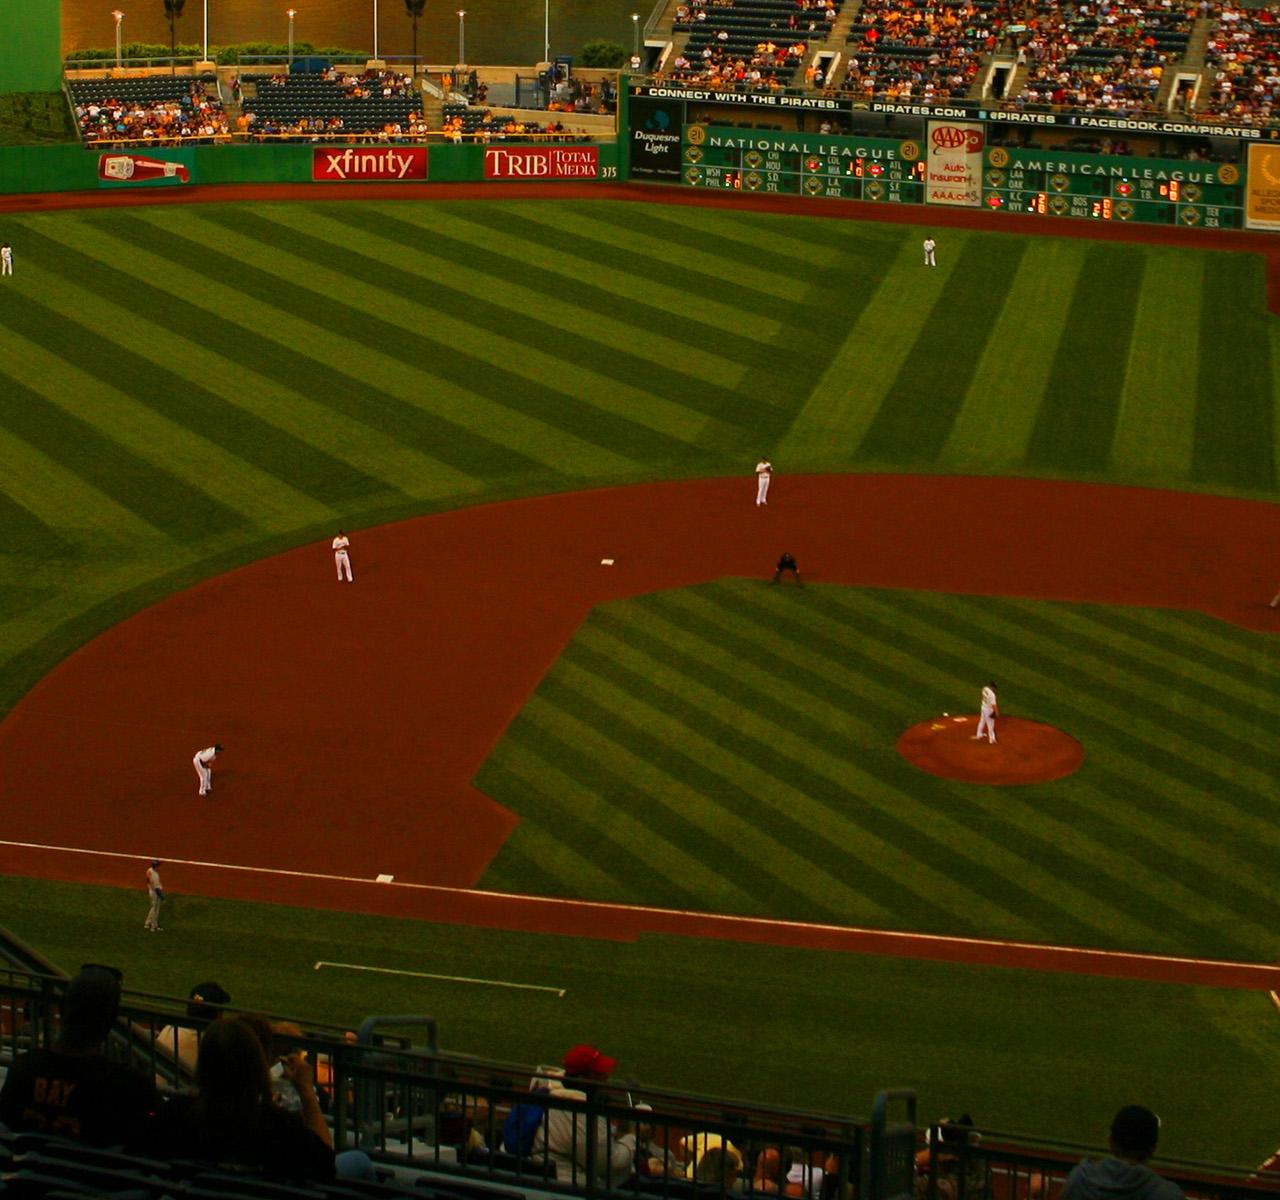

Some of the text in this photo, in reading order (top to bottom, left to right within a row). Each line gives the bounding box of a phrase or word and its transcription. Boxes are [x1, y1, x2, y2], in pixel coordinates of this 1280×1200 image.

[648, 88, 711, 100] CONNECT
[715, 93, 747, 103] WITH
[750, 95, 777, 105] THE
[780, 97, 840, 109] PIRATES:
[873, 104, 967, 118] PIRATES.COM
[990, 111, 1056, 124] @PIRATES
[1080, 117, 1261, 139] FACEBOOK.COM/PIRATES
[634, 131, 680, 145] Duquesne
[934, 128, 964, 145] AAA
[644, 141, 669, 155] Light
[710, 137, 895, 160] NATIONAL LEAGUE
[326, 148, 414, 179] xfinity
[486, 150, 549, 177] TRIB
[553, 150, 596, 164] TOTAL
[555, 163, 597, 177] MEDIA
[601, 166, 617, 178] 375
[943, 163, 965, 172] Auto
[1013, 160, 1214, 183] AMERICAN LEAGUE
[705, 178, 720, 186] PHIL
